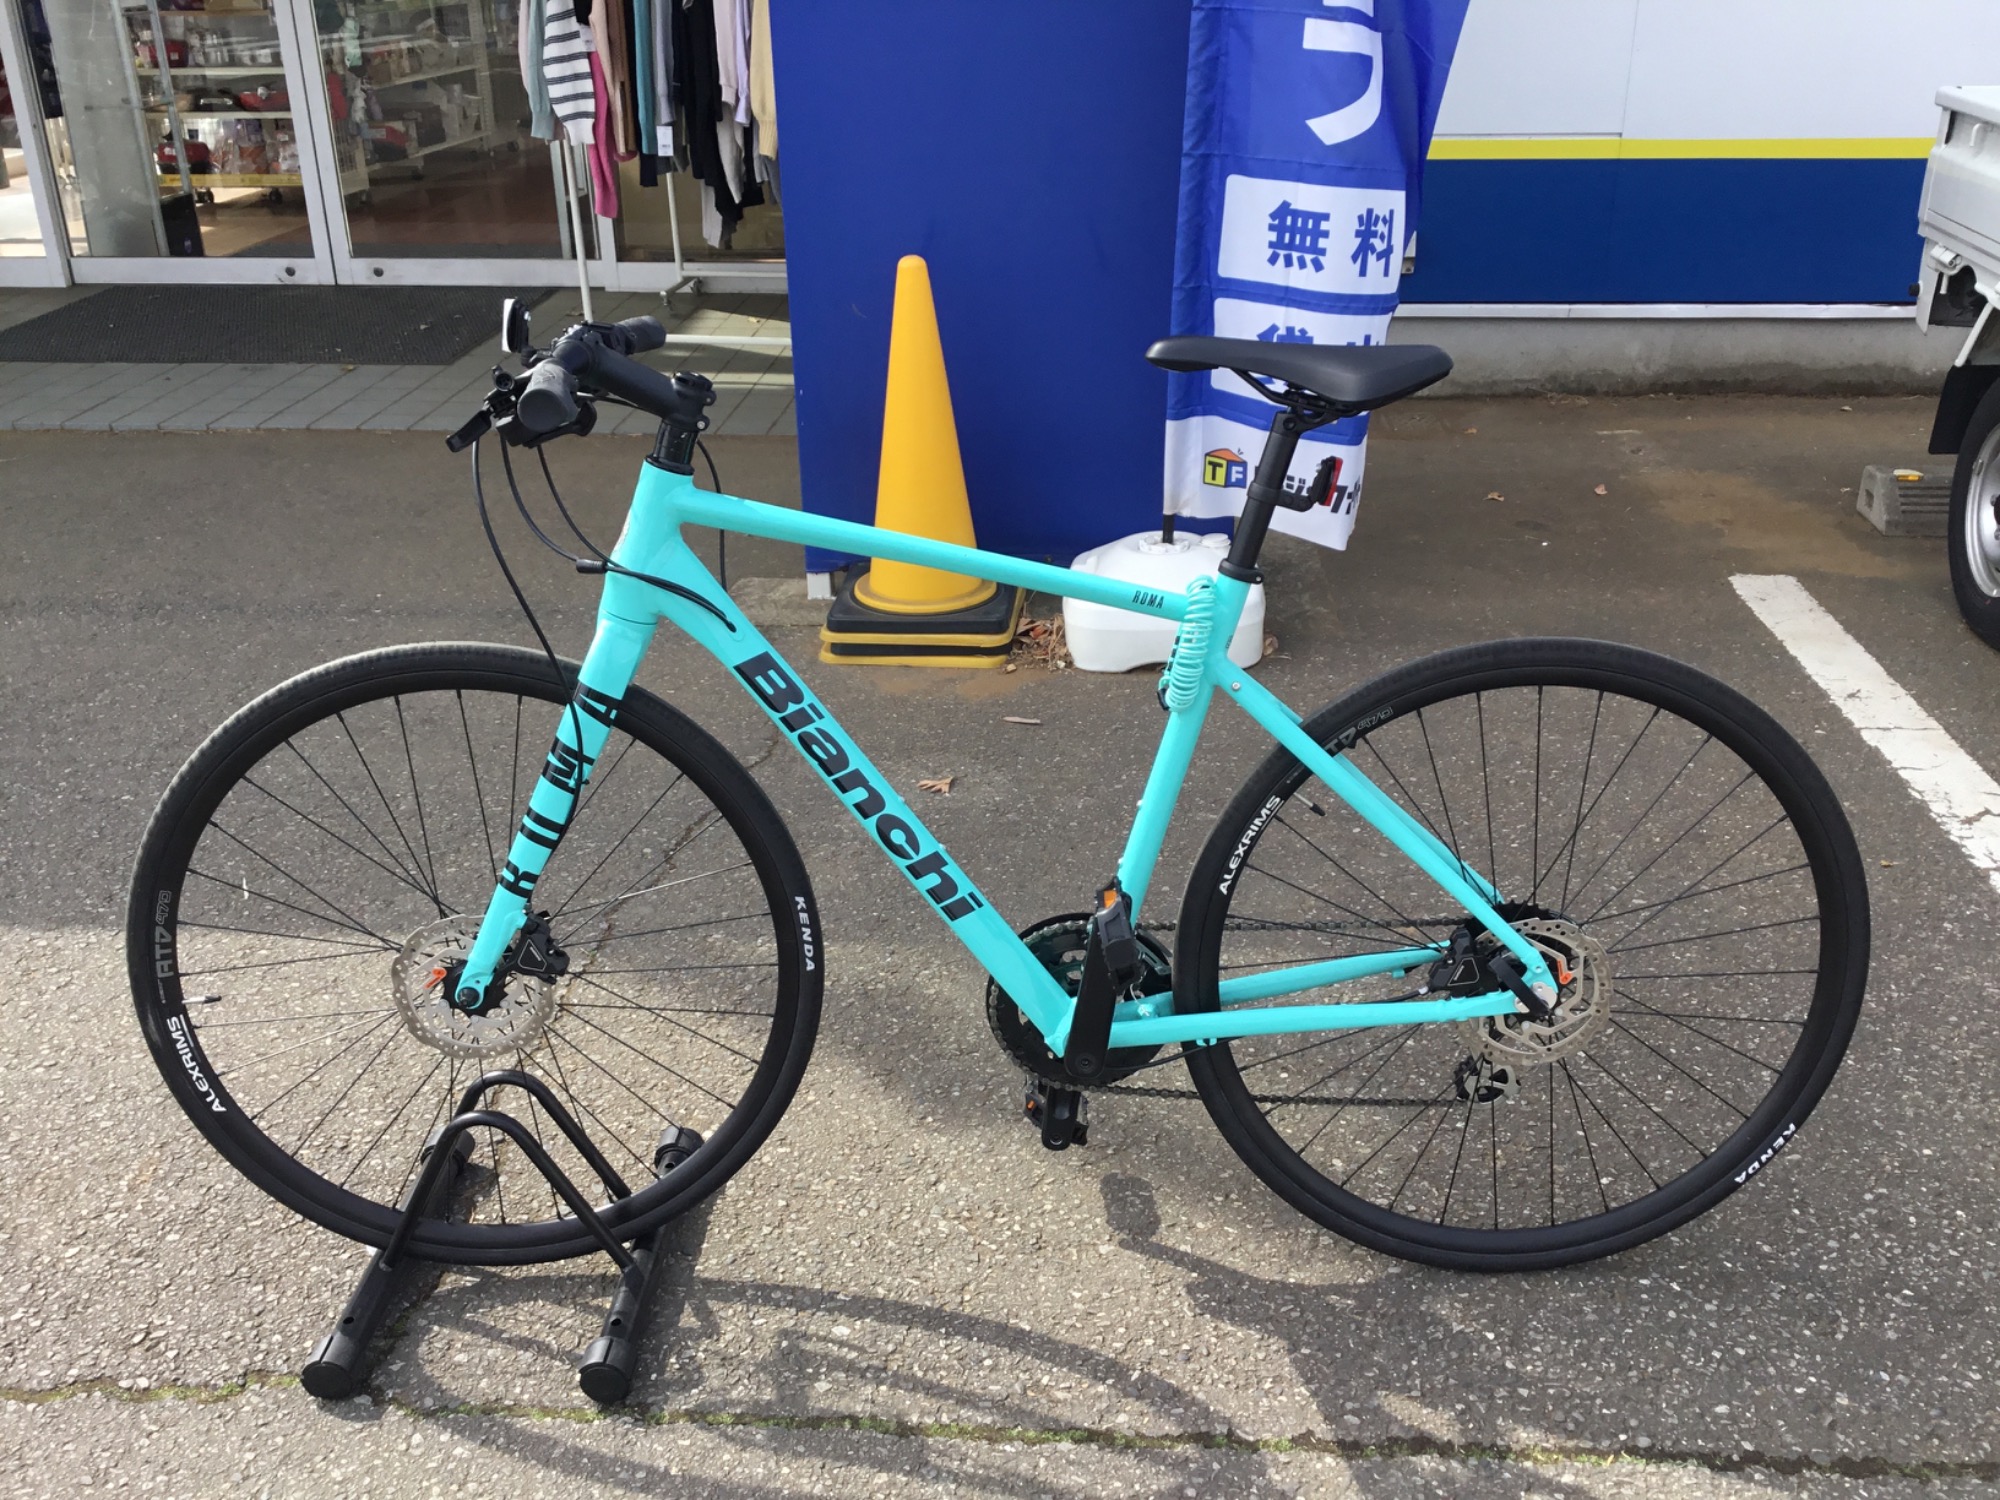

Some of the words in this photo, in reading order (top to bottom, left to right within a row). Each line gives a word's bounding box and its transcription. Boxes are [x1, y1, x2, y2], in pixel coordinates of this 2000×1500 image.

[1267, 200, 1395, 278] 無料
[1132, 590, 1165, 609] ROMA
[733, 651, 984, 921] Bianchi
[1219, 795, 1281, 895] ALEXRIMS
[795, 896, 816, 972] KENDA
[167, 1015, 227, 1113] ALEXRIMS
[1734, 1123, 1796, 1183] KENDA
